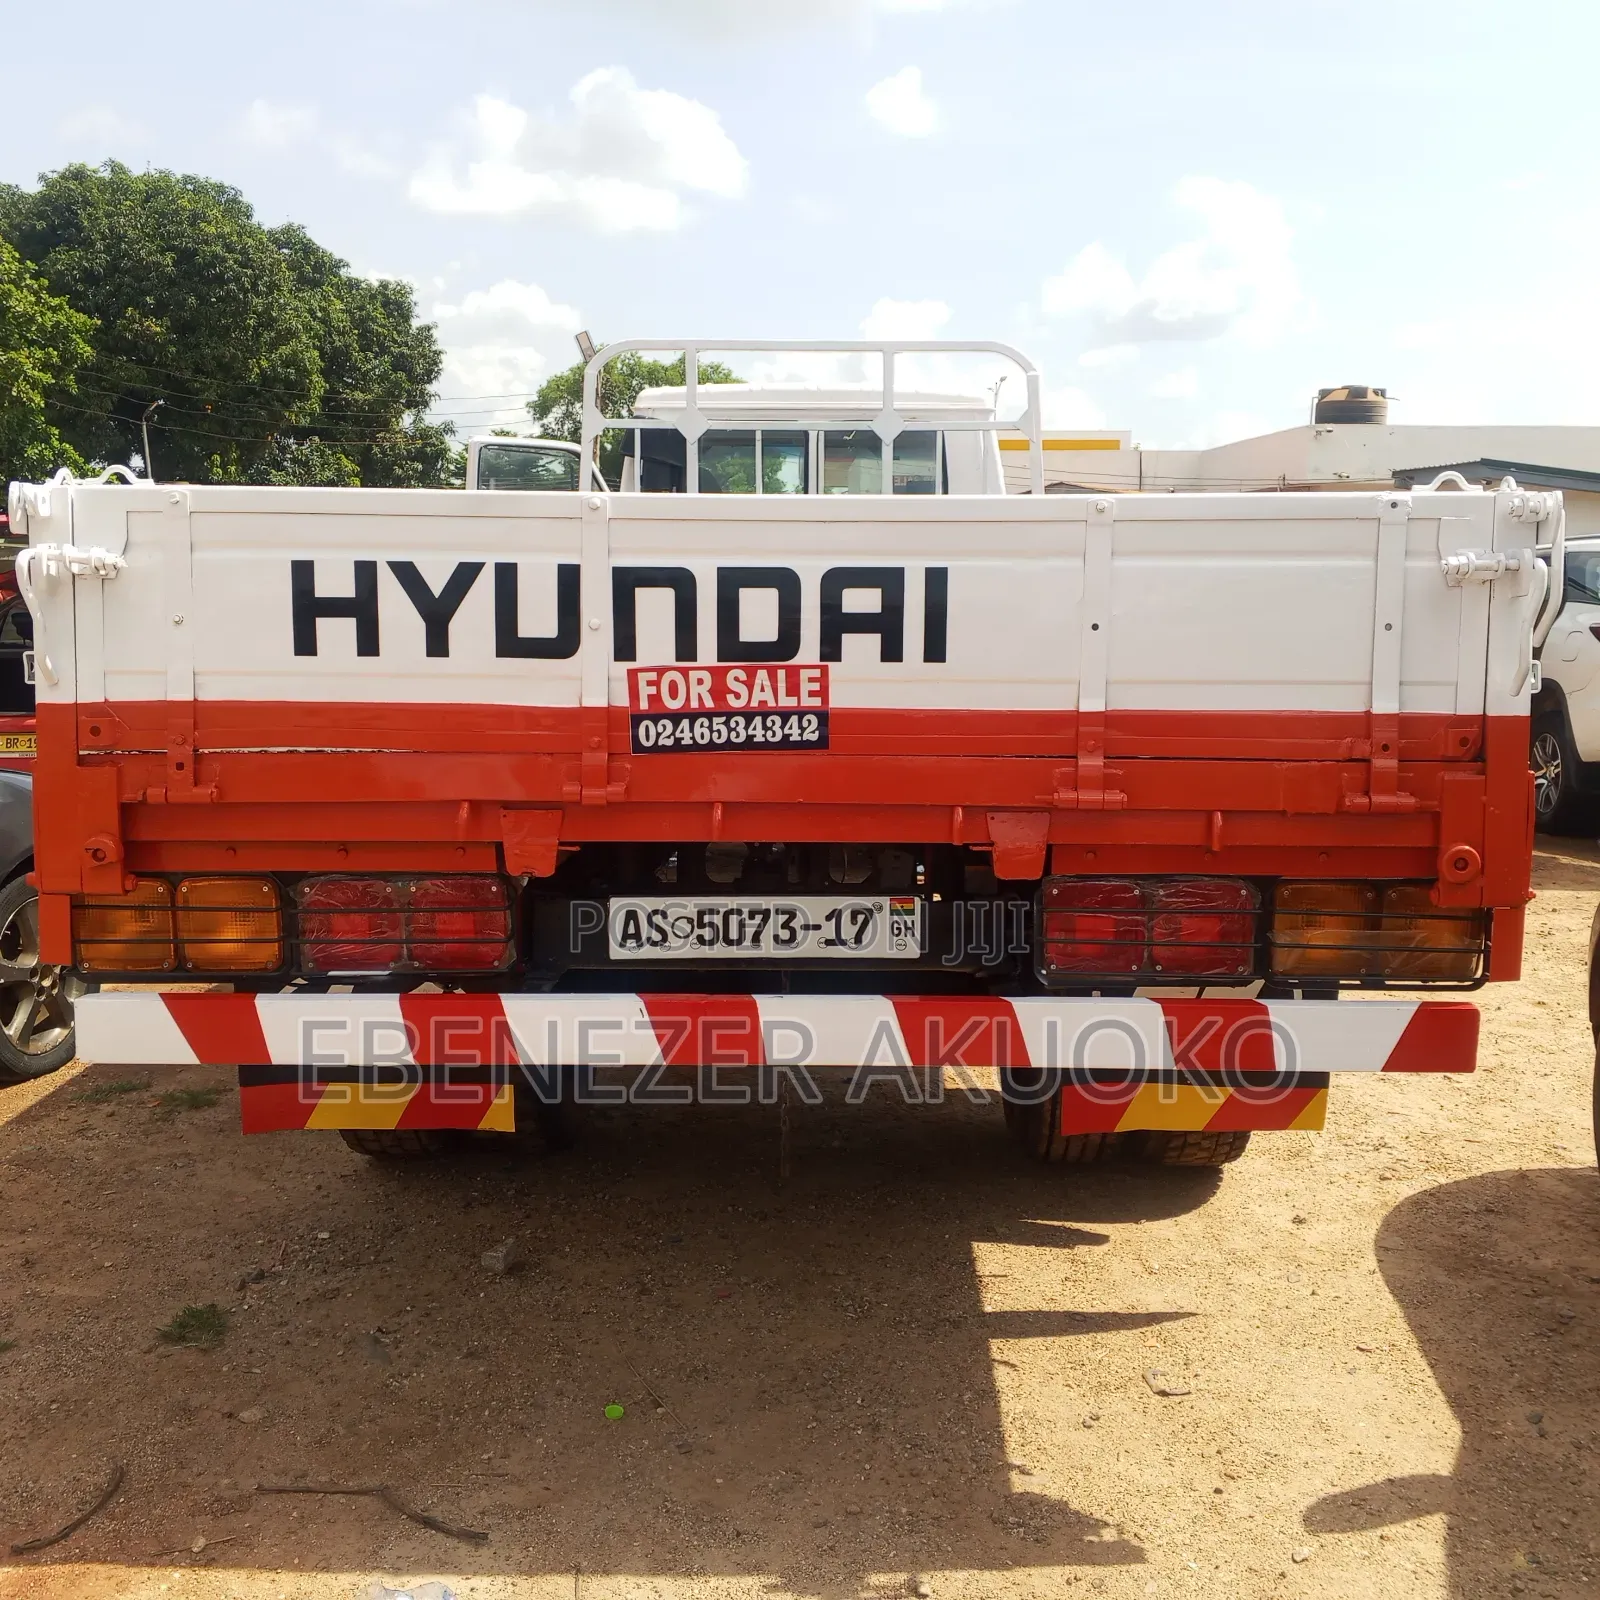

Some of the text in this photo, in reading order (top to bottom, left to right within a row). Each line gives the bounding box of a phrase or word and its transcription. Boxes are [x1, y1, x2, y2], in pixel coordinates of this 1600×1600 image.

[290, 559, 949, 663] HYUNDAI
[637, 668, 822, 710] FOR SALE
[5, 737, 19, 749] BR
[638, 714, 819, 747] 0246534342
[619, 907, 875, 949] AS 5073-17
[890, 919, 916, 938] GH
